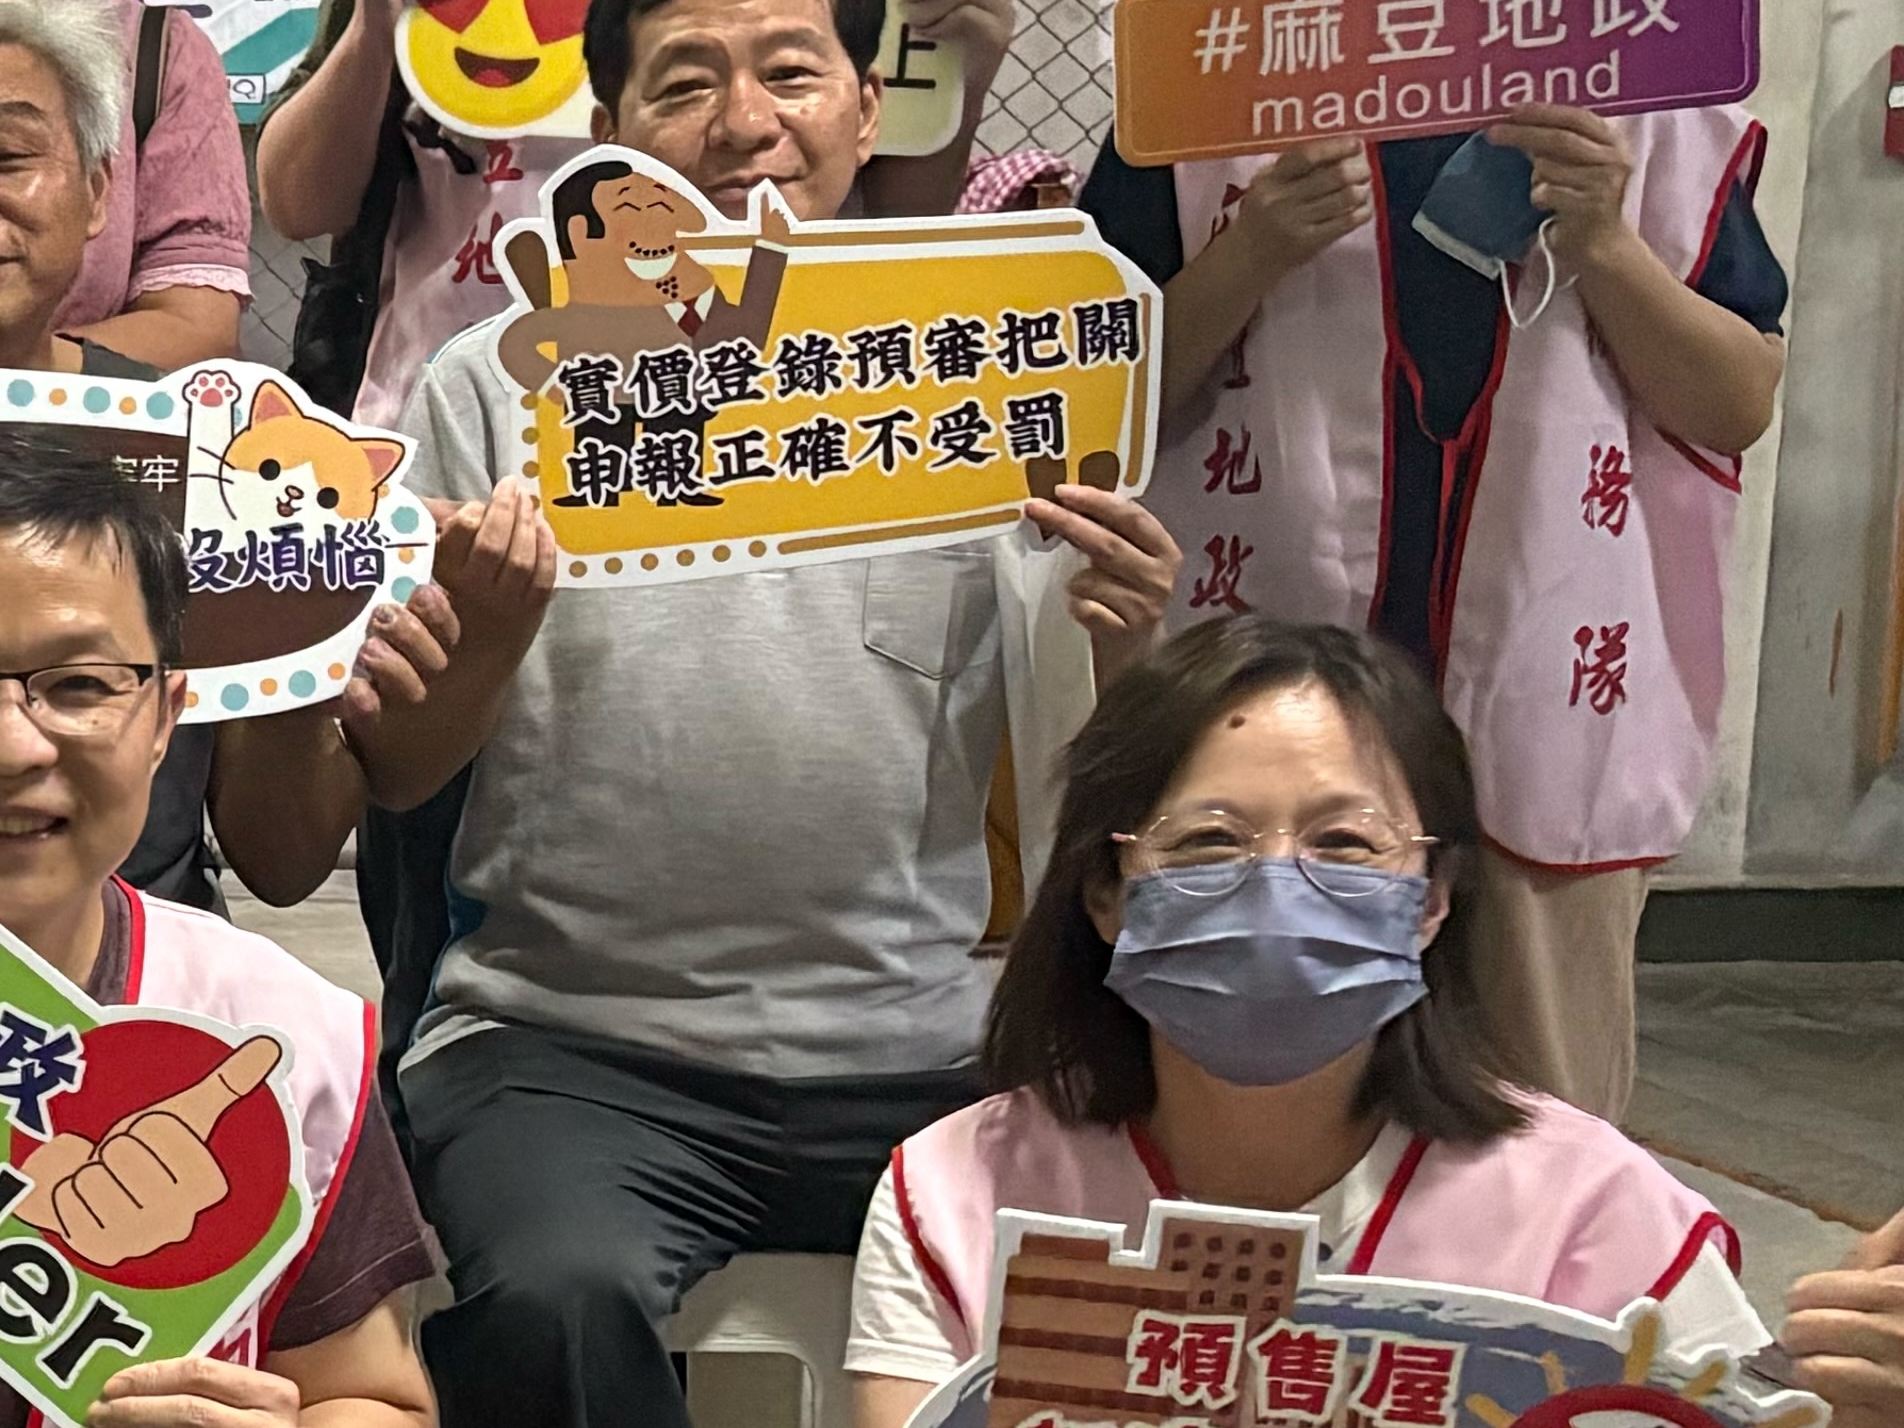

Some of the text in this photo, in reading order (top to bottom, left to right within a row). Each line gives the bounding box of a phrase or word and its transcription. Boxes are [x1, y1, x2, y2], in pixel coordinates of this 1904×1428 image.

[1251, 52, 1622, 137] madouland
[559, 298, 1141, 426] 實價登錄預審把關
[565, 391, 1067, 508] 申報正確不受罰
